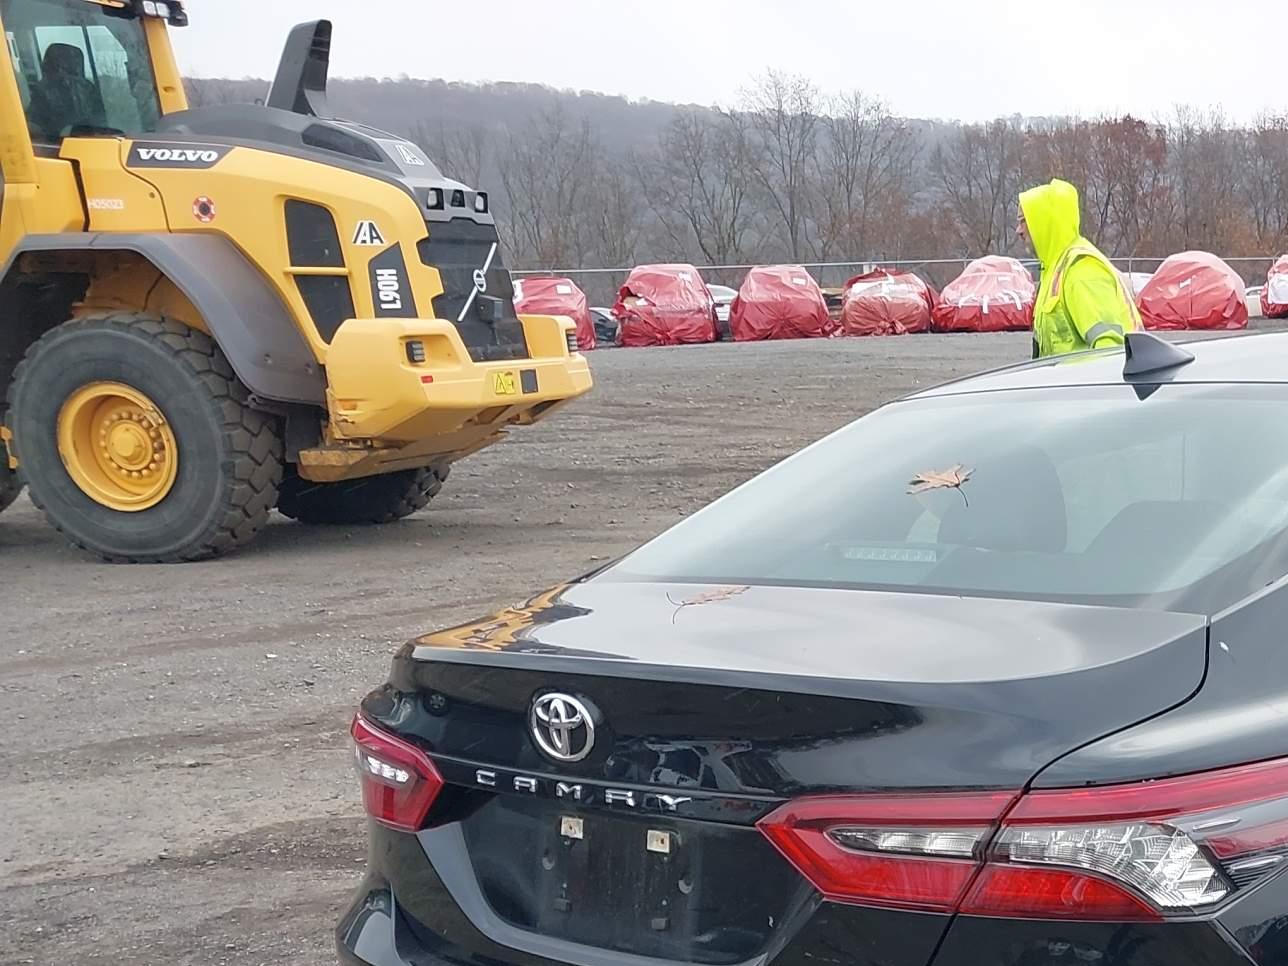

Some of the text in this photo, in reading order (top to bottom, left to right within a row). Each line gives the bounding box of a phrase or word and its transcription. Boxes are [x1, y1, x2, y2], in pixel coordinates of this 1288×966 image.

[137, 148, 219, 162] VOLVO
[375, 268, 402, 310] L90H
[475, 769, 692, 811] CAMRY
